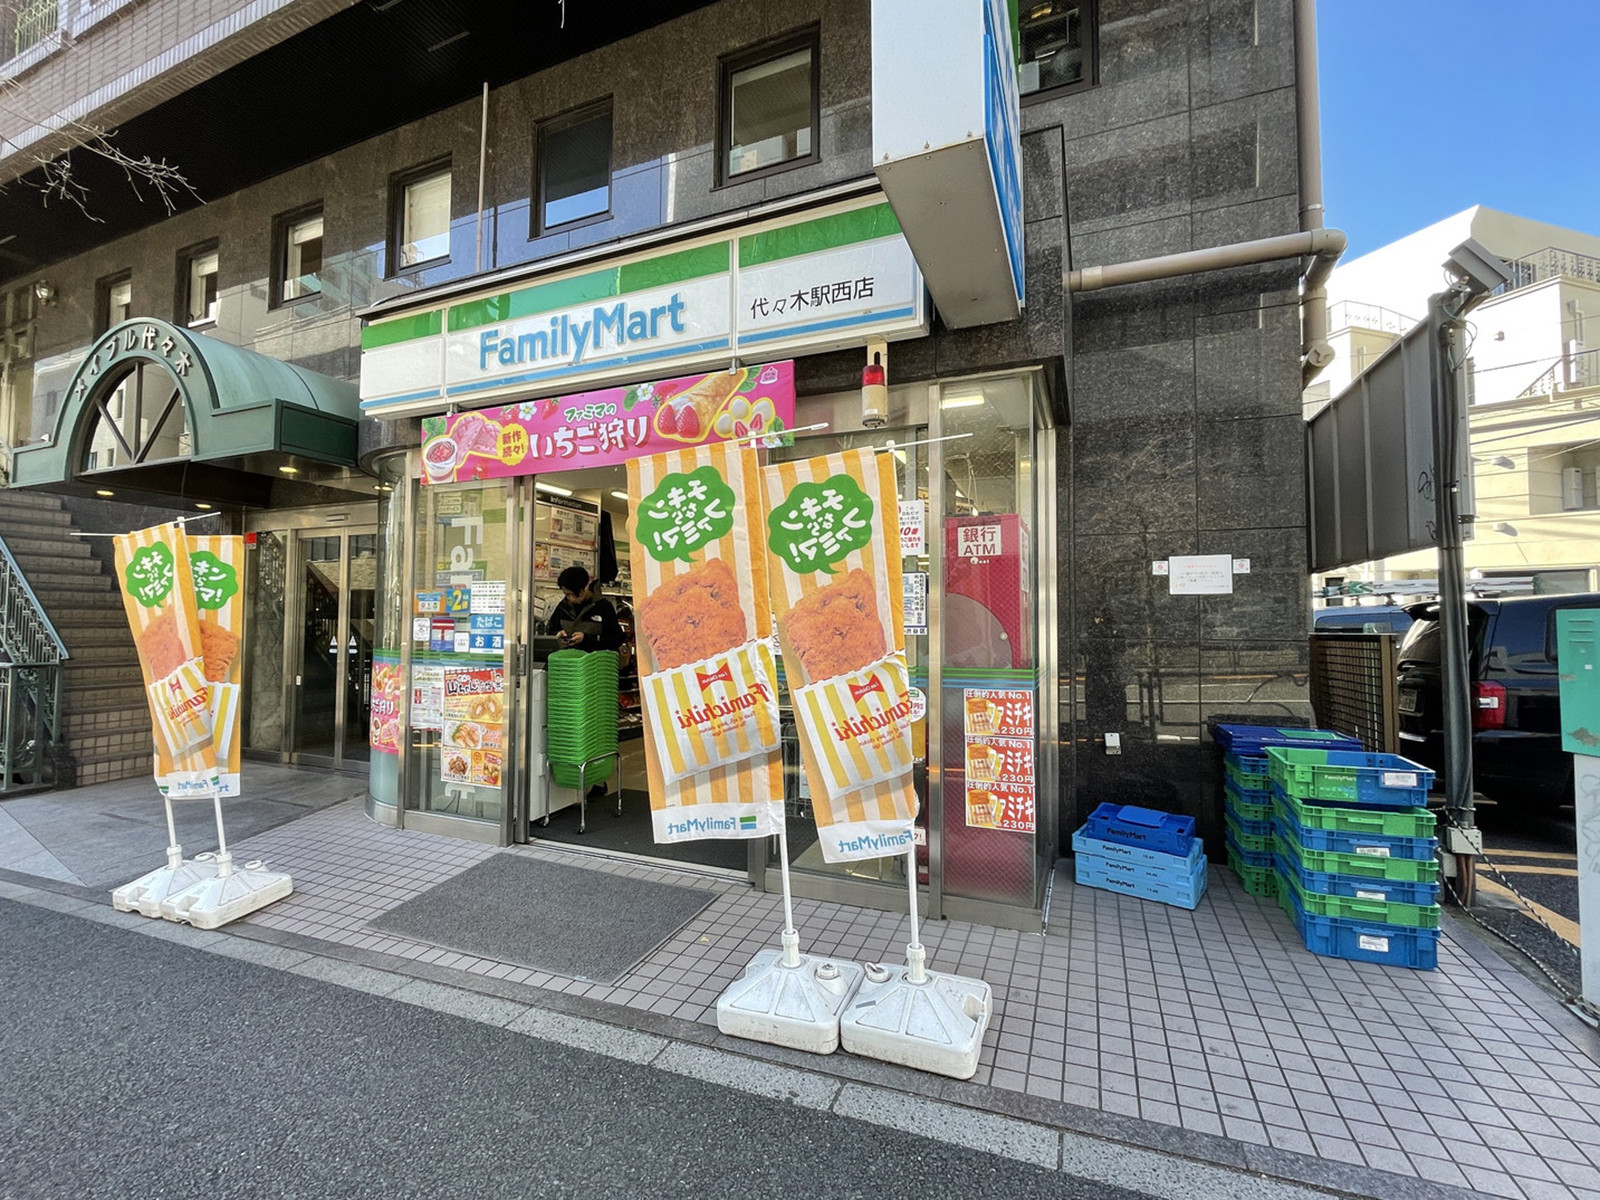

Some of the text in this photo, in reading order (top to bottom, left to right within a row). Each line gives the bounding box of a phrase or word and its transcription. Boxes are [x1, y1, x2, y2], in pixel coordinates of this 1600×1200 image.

[750, 277, 874, 319] 代々木駅西店
[479, 293, 686, 370] FamilyMart
[564, 403, 617, 422] ファミマの
[502, 432, 521, 445] 新作
[529, 415, 649, 458] いちご狩り
[963, 527, 996, 542] 銀行
[963, 544, 996, 555] ATM
[190, 558, 227, 581] キン
[476, 616, 502, 628] たばこ
[475, 635, 501, 648] お酒
[1008, 691, 1030, 700] No.1
[988, 702, 1033, 727] ファミチキ
[1001, 726, 1034, 735] 230円
[1009, 739, 1031, 749] No.1
[989, 748, 1033, 775] ファミチキ
[1002, 773, 1034, 783] 230円
[1324, 774, 1356, 782] FamilyMart
[1010, 784, 1032, 794] No.1
[989, 794, 1034, 821] ファミチキ
[1003, 819, 1034, 830] 230円
[1106, 827, 1147, 840] FamilyMart
[1102, 844, 1131, 856] FamilyMart
[1105, 861, 1135, 873] FamilyMart
[1105, 877, 1135, 889] FamilyMart
